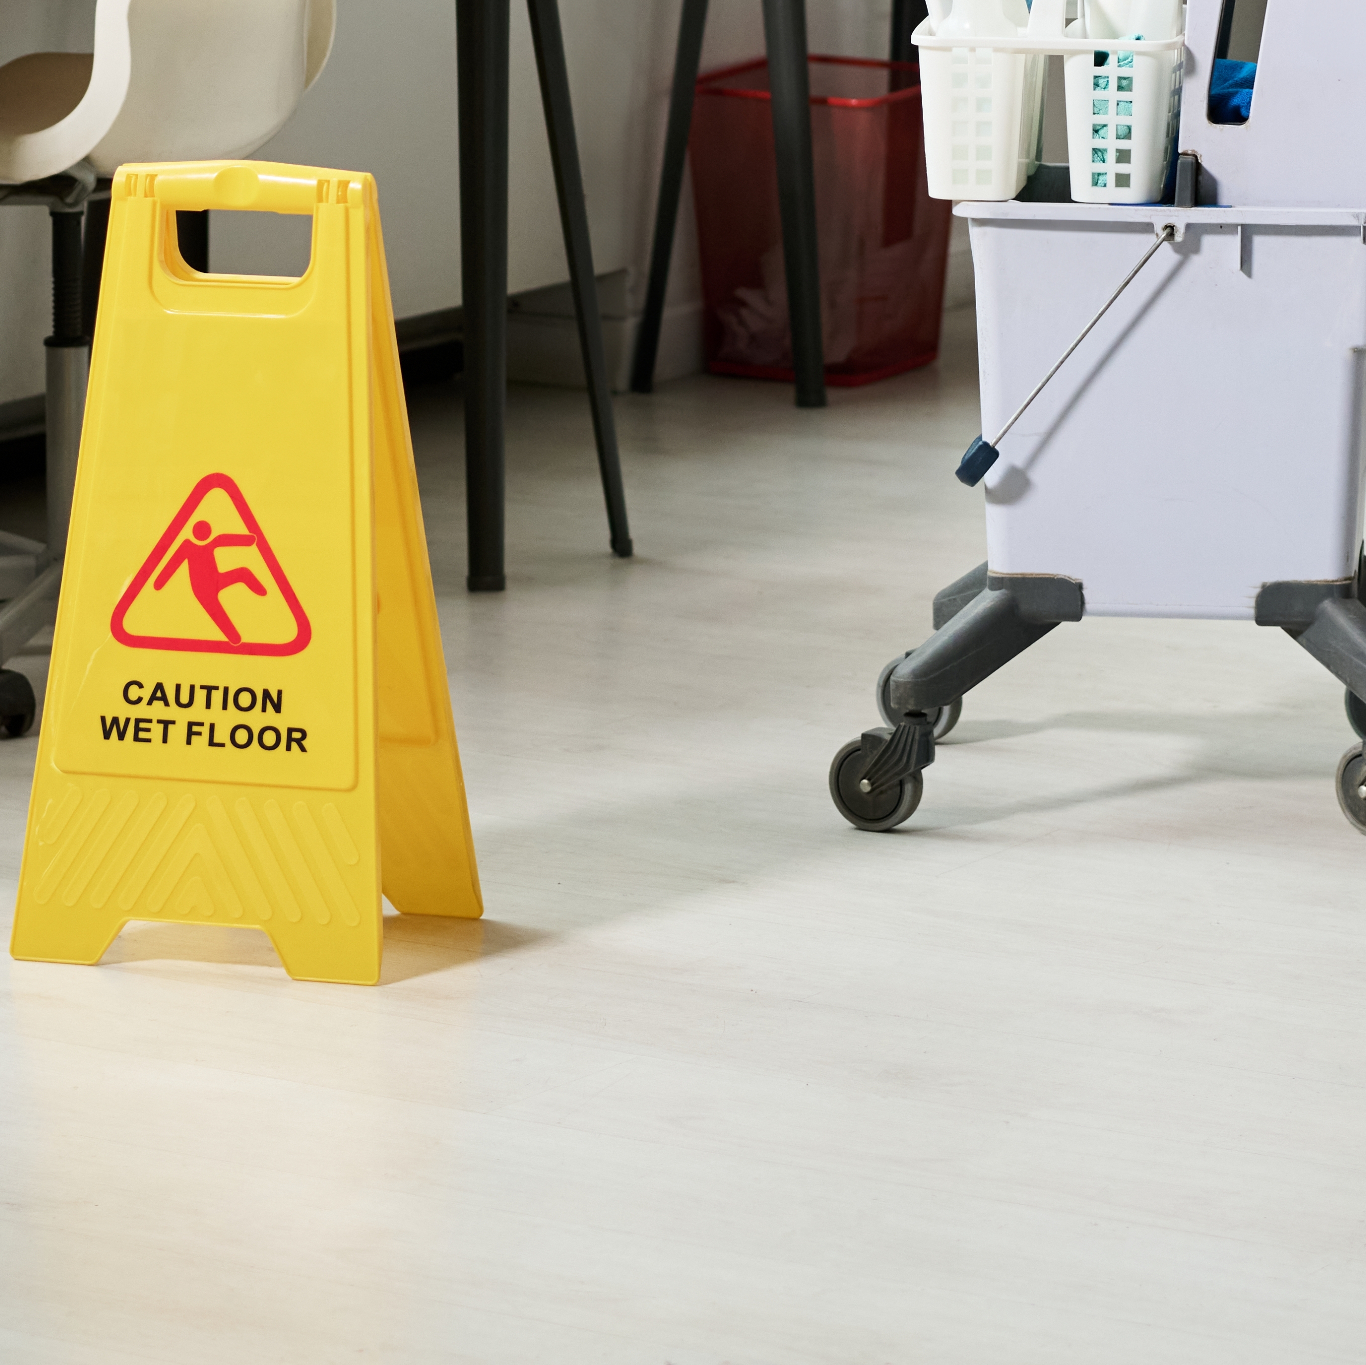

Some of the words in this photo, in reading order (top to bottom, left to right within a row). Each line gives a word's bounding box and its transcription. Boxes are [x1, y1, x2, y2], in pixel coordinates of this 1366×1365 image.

[122, 679, 283, 714] CAUTION
[99, 715, 177, 744] WET
[185, 720, 308, 753] FLOOR
